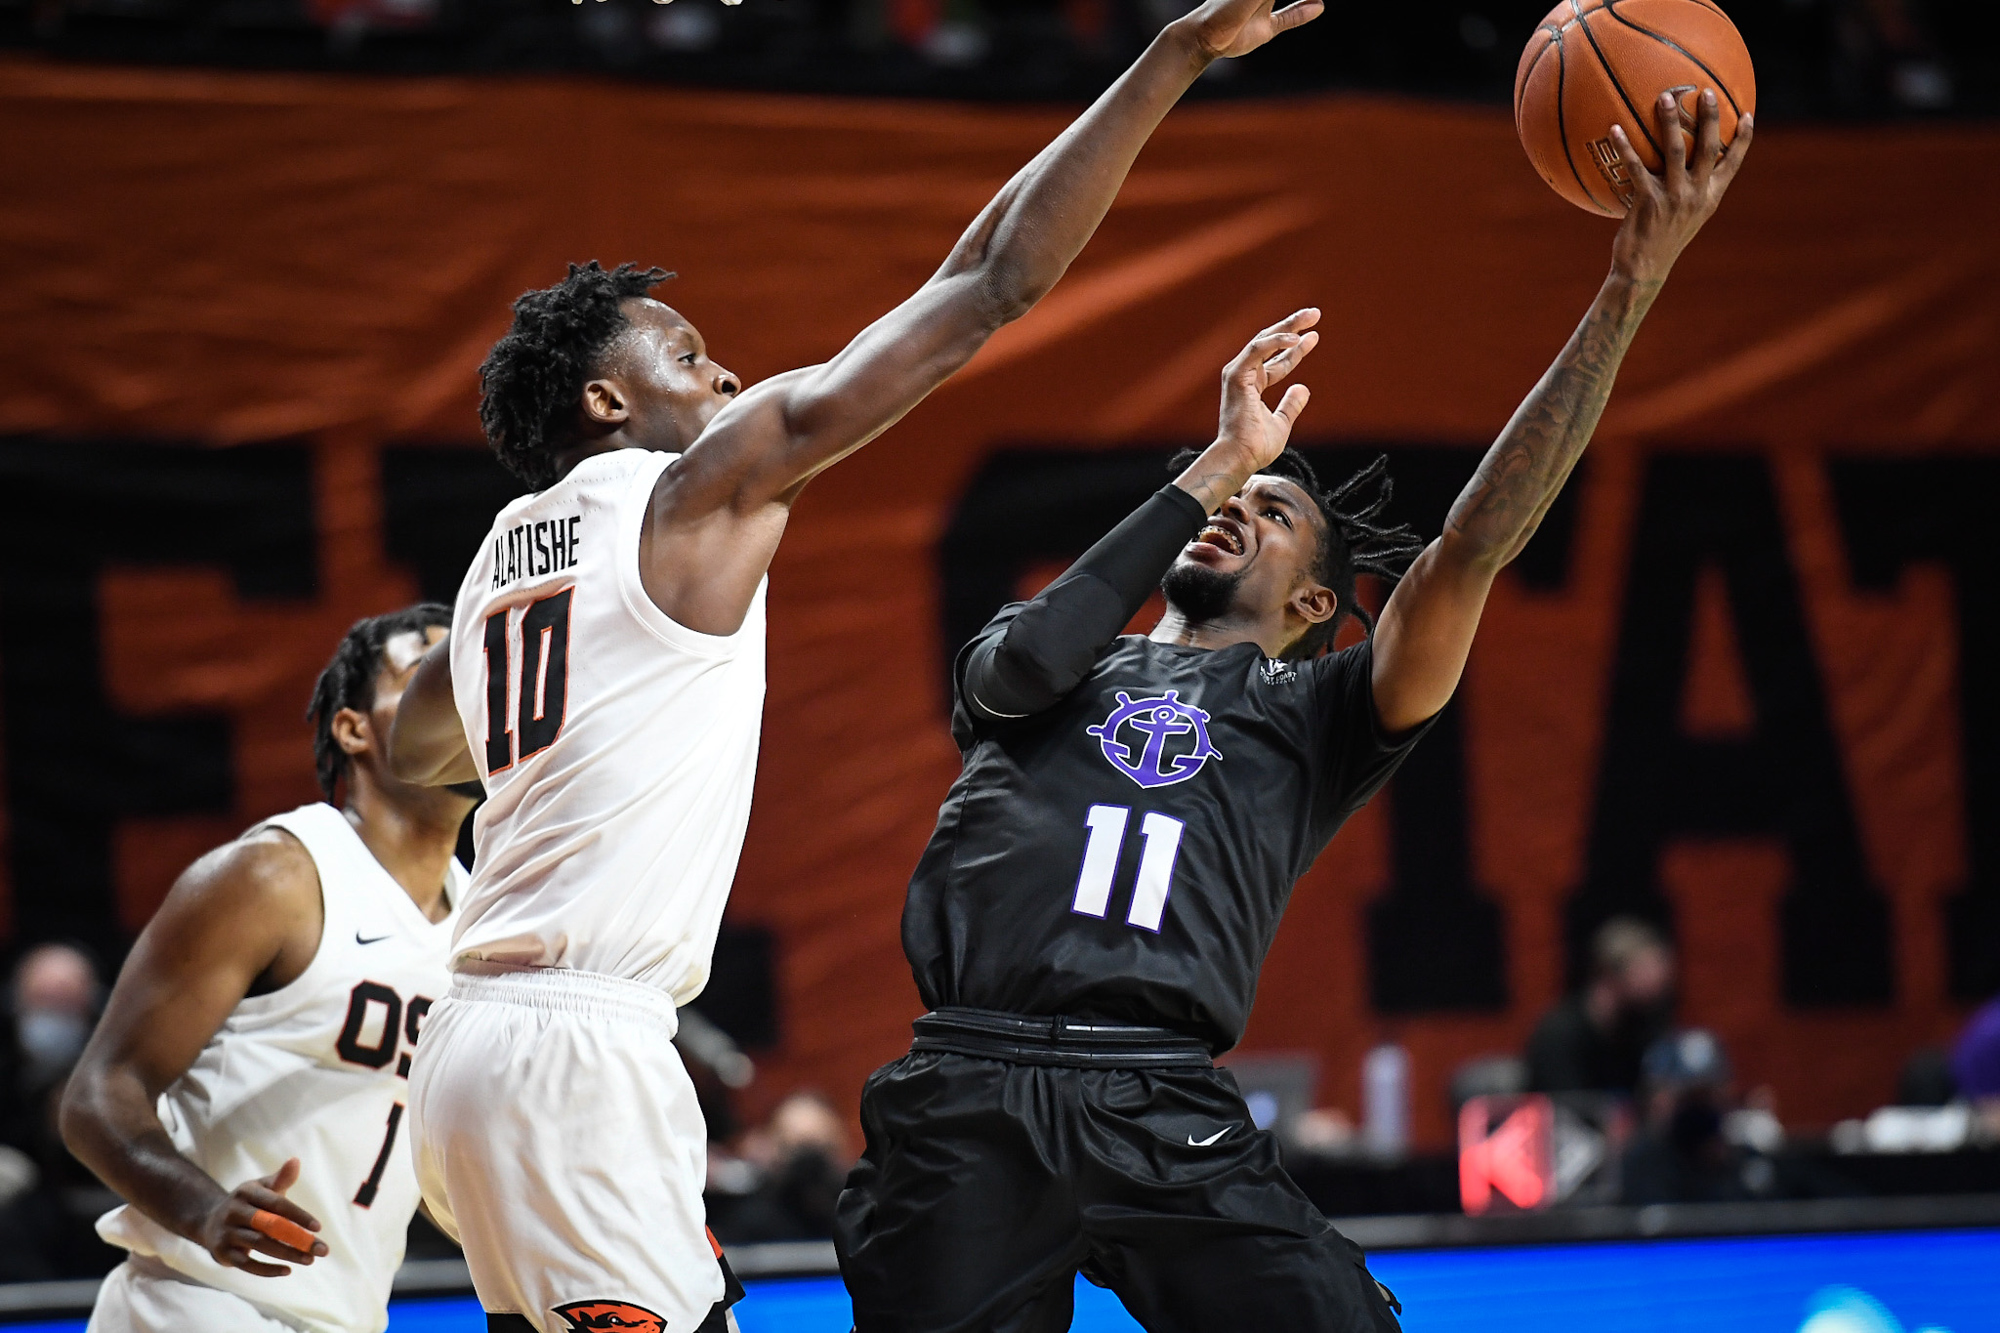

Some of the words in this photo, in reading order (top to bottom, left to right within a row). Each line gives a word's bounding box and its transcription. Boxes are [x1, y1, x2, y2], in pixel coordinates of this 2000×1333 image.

[491, 515, 581, 592] ALATISHE
[483, 585, 575, 777] 10
[1070, 803, 1186, 934] 11
[352, 1101, 404, 1210] 1
